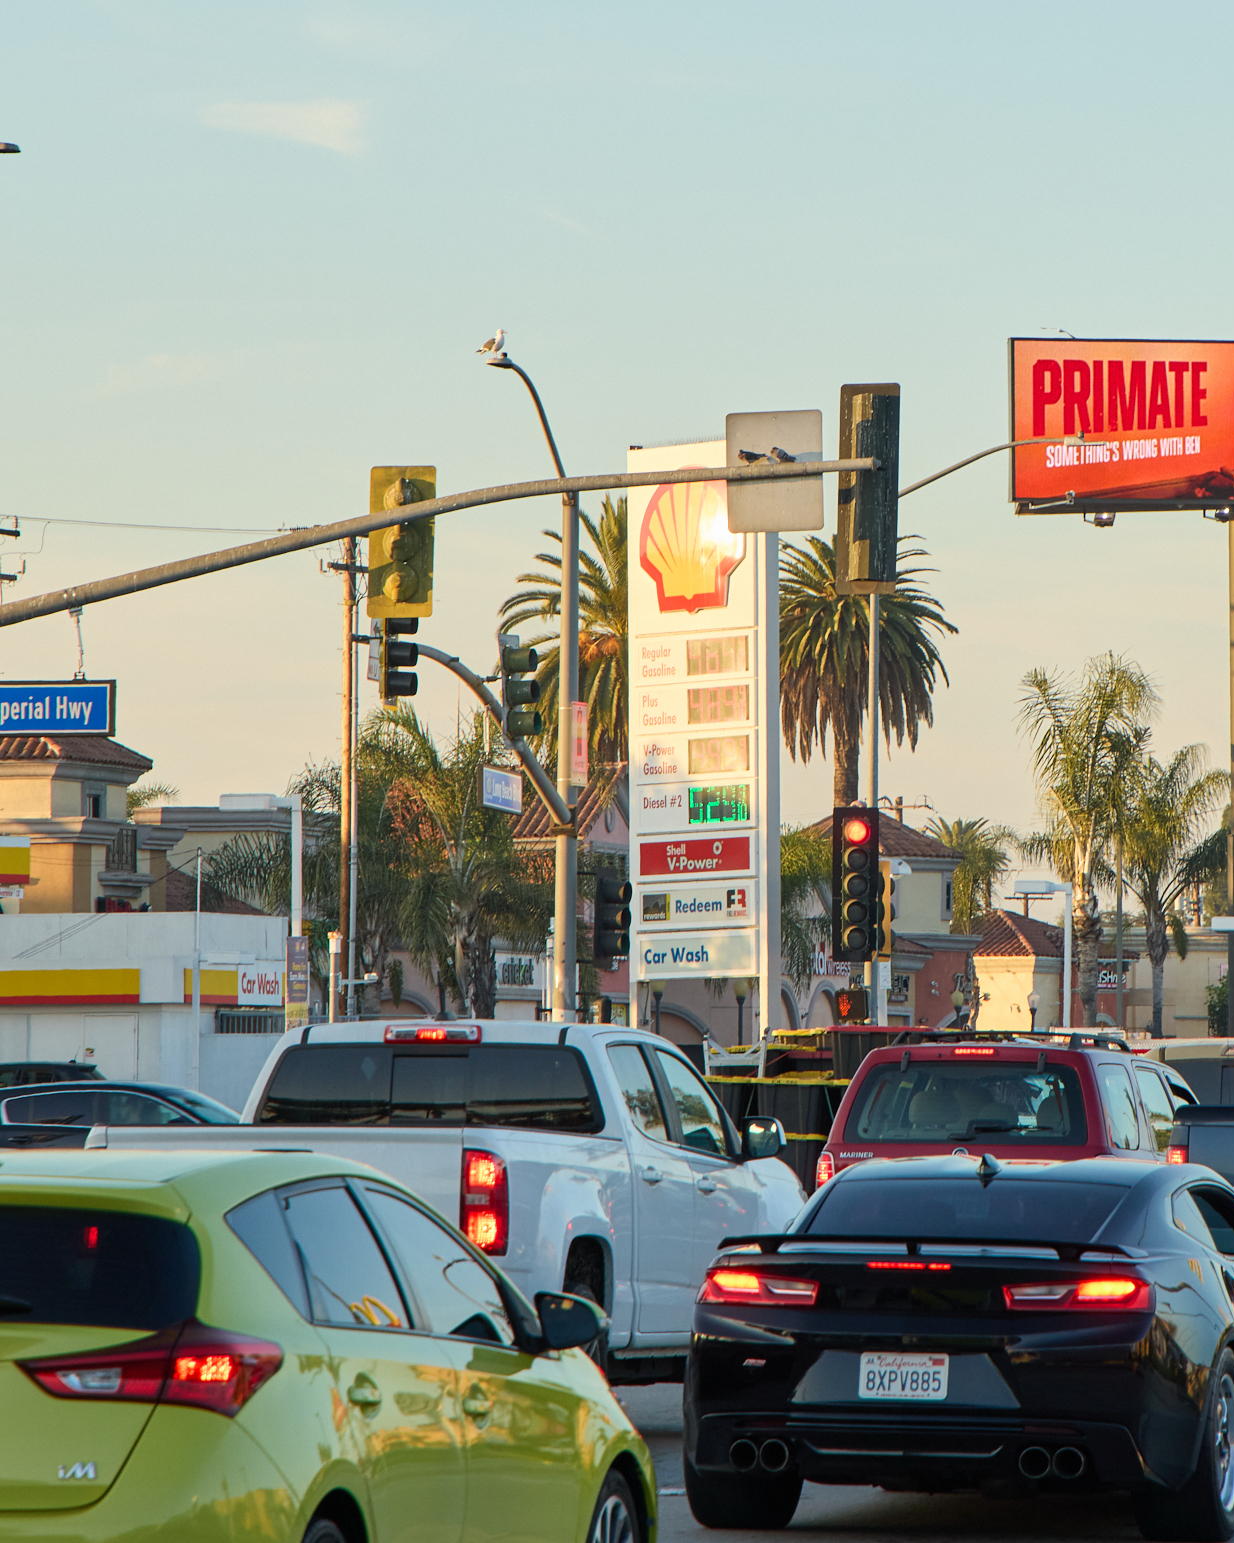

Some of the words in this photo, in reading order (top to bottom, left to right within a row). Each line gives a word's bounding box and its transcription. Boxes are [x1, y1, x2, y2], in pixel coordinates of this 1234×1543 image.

[1032, 359, 1208, 437] PRIMATE
[1046, 440, 1120, 468] SOMETHING'S
[1122, 438, 1158, 461] WRONG
[1159, 437, 1184, 457] WITH
[1184, 435, 1201, 455] BEN
[642, 645, 671, 661] Regular
[642, 663, 676, 678] Gasoline
[643, 695, 658, 708] Plus
[0, 696, 50, 726] perial
[56, 696, 93, 725] Hwy
[643, 712, 677, 726] Gasoline
[643, 744, 675, 757] V-Power
[643, 761, 678, 775] Gasoline
[643, 795, 667, 809] Diesel
[669, 795, 682, 808] #2
[666, 843, 686, 856] Shell
[667, 856, 719, 871] V-Power
[643, 911, 666, 920] rewards
[675, 898, 722, 913] Redeem
[644, 949, 667, 964] Car
[671, 945, 709, 963] Wash
[241, 972, 256, 994] Car
[257, 972, 279, 995] Wash
[879, 1356, 929, 1370] California
[866, 1369, 941, 1392] 8XPV885
[58, 1461, 96, 1479] iM
